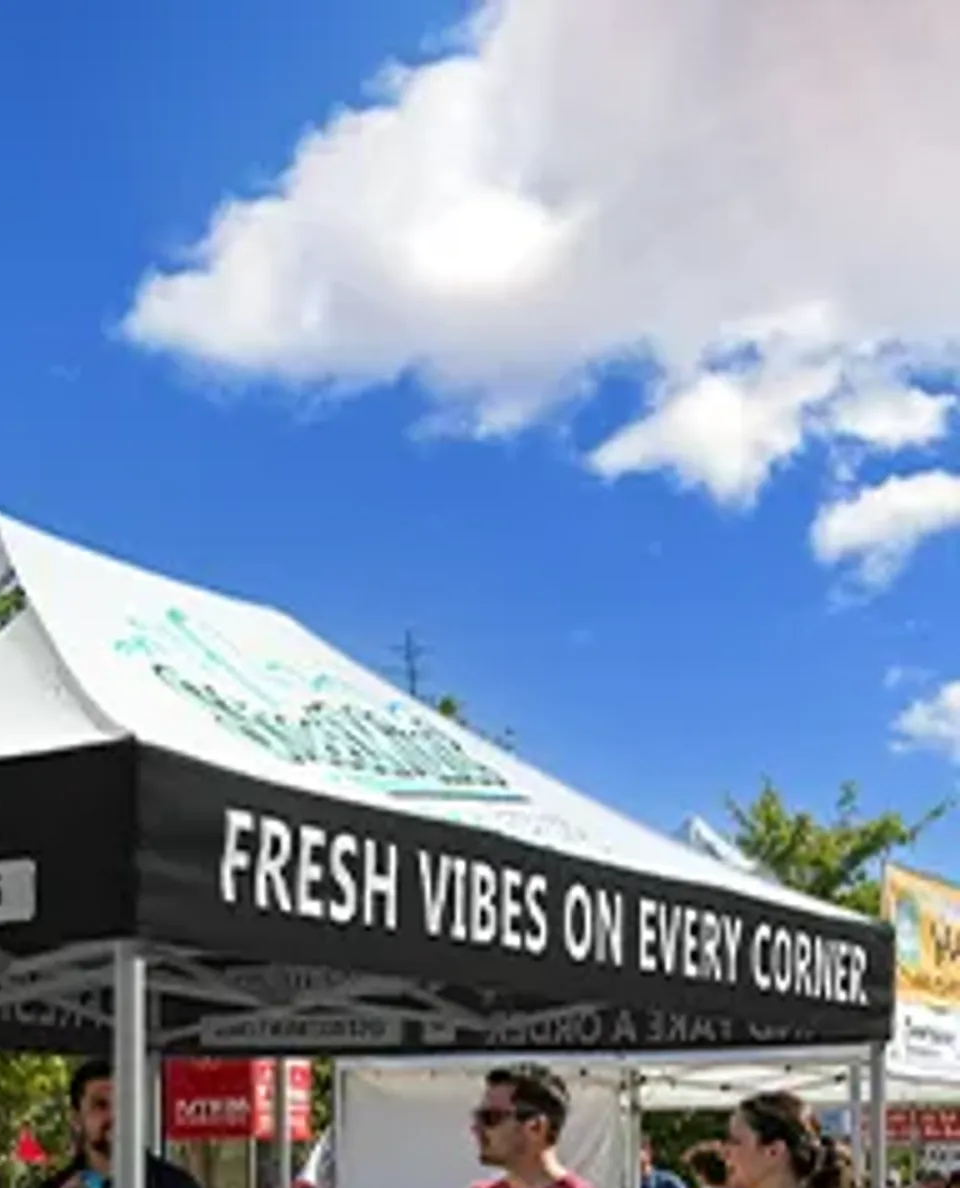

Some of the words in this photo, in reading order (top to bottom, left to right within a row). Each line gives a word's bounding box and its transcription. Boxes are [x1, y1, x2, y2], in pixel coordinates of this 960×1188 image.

[220, 808, 397, 930] FRESH
[419, 850, 548, 953] VIBES
[564, 884, 623, 966] ON
[640, 901, 742, 983] EVERY
